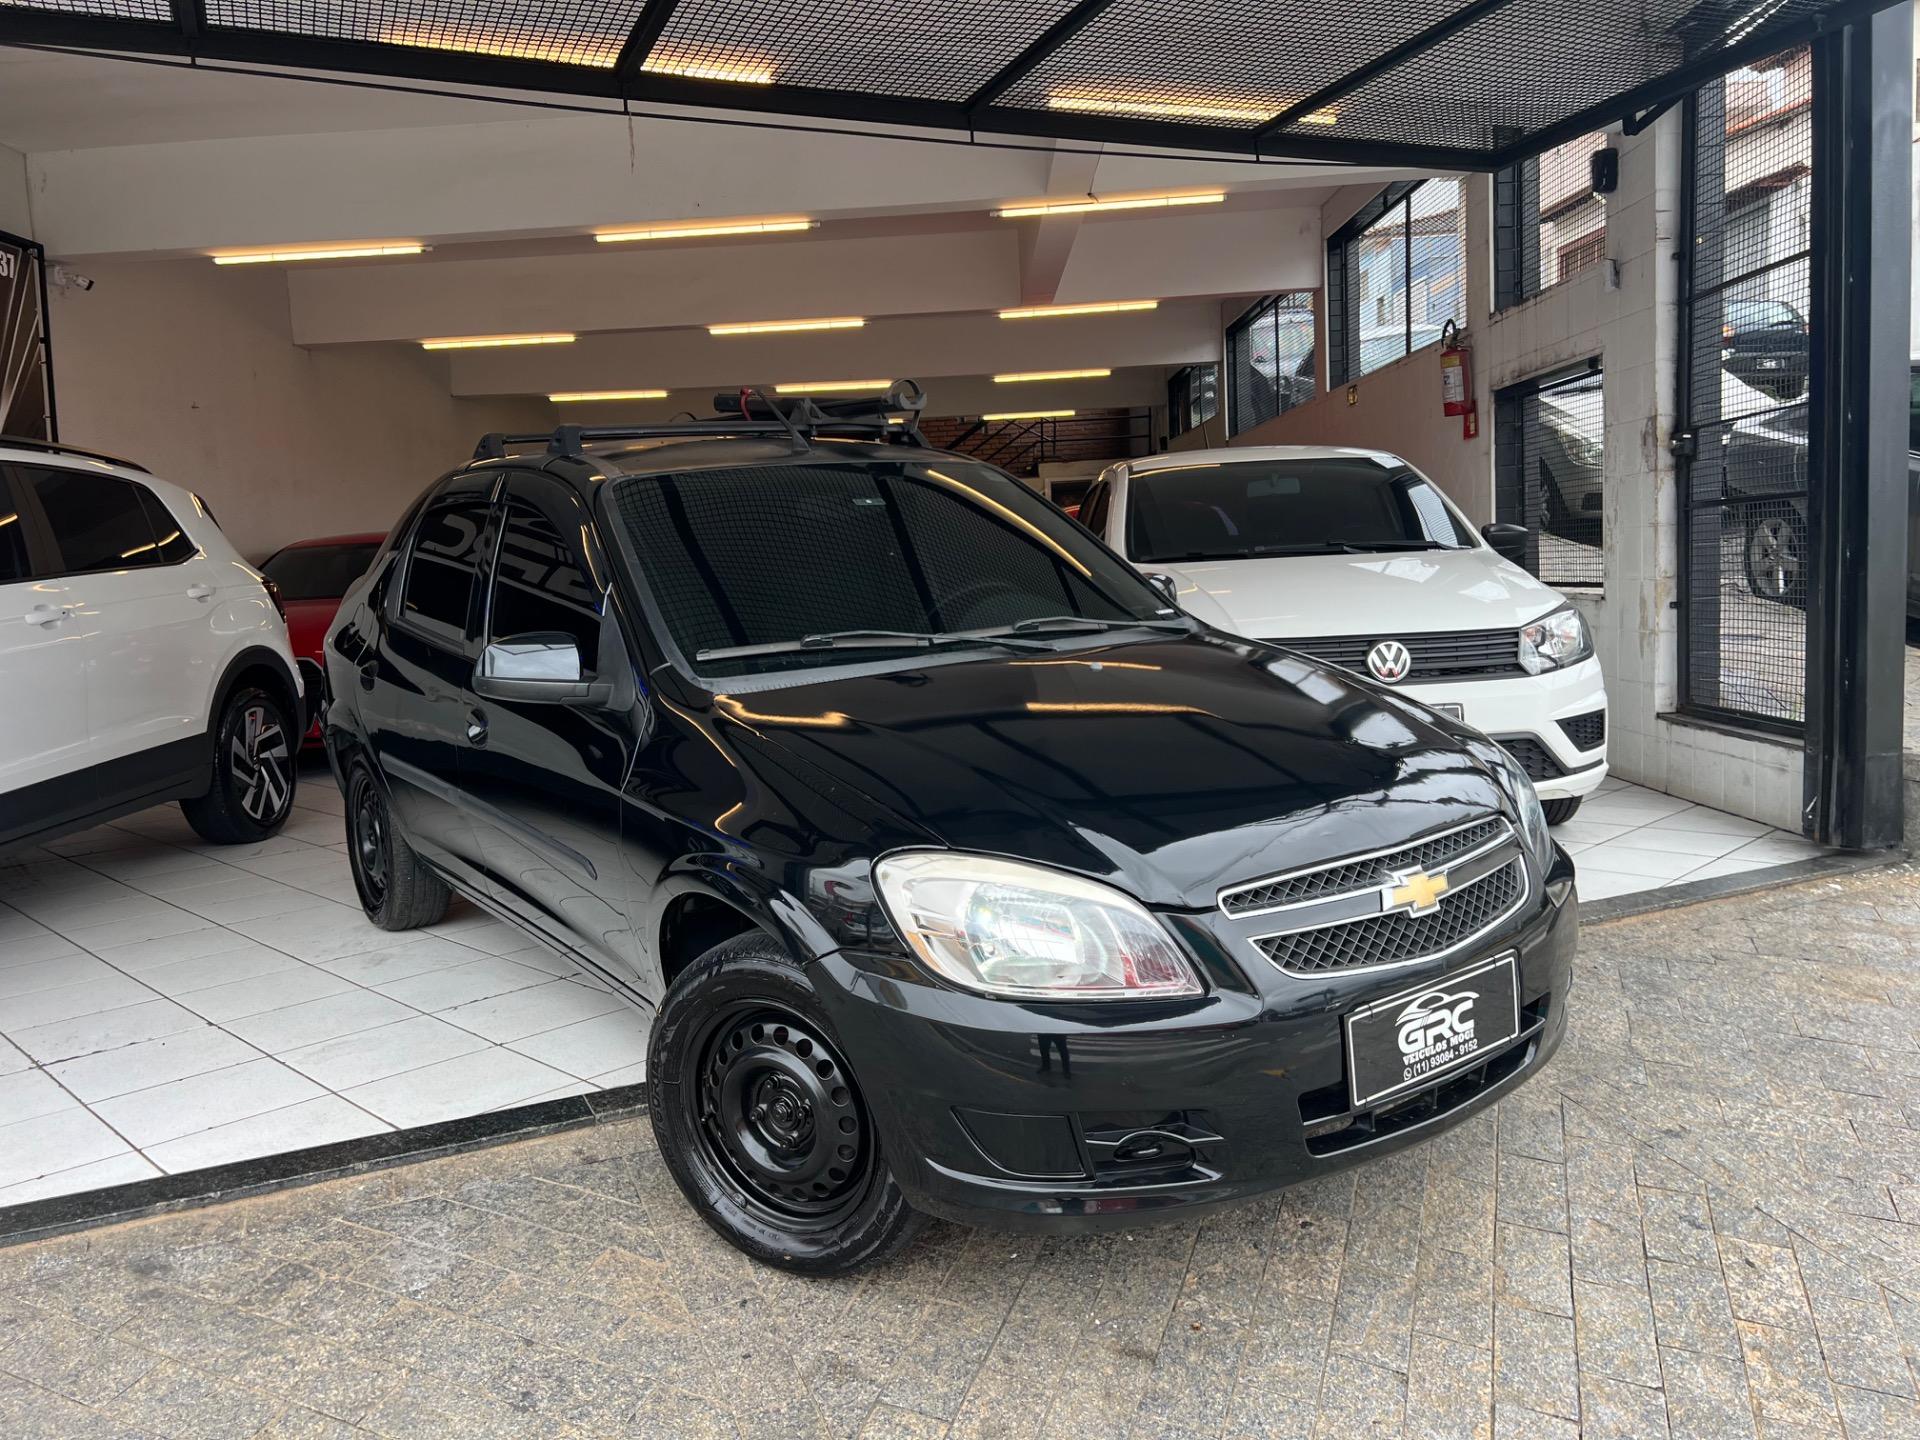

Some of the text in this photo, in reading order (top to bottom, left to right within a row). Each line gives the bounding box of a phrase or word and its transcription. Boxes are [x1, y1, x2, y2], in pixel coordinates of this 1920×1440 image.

[1370, 642, 1409, 680] VW
[1398, 998, 1475, 1054] GRC
[1402, 1039, 1448, 1066] VEICULOS
[1413, 1059, 1430, 1077] (11)
[1430, 1048, 1455, 1068] 93084
[1459, 1038, 1478, 1056] 9152
